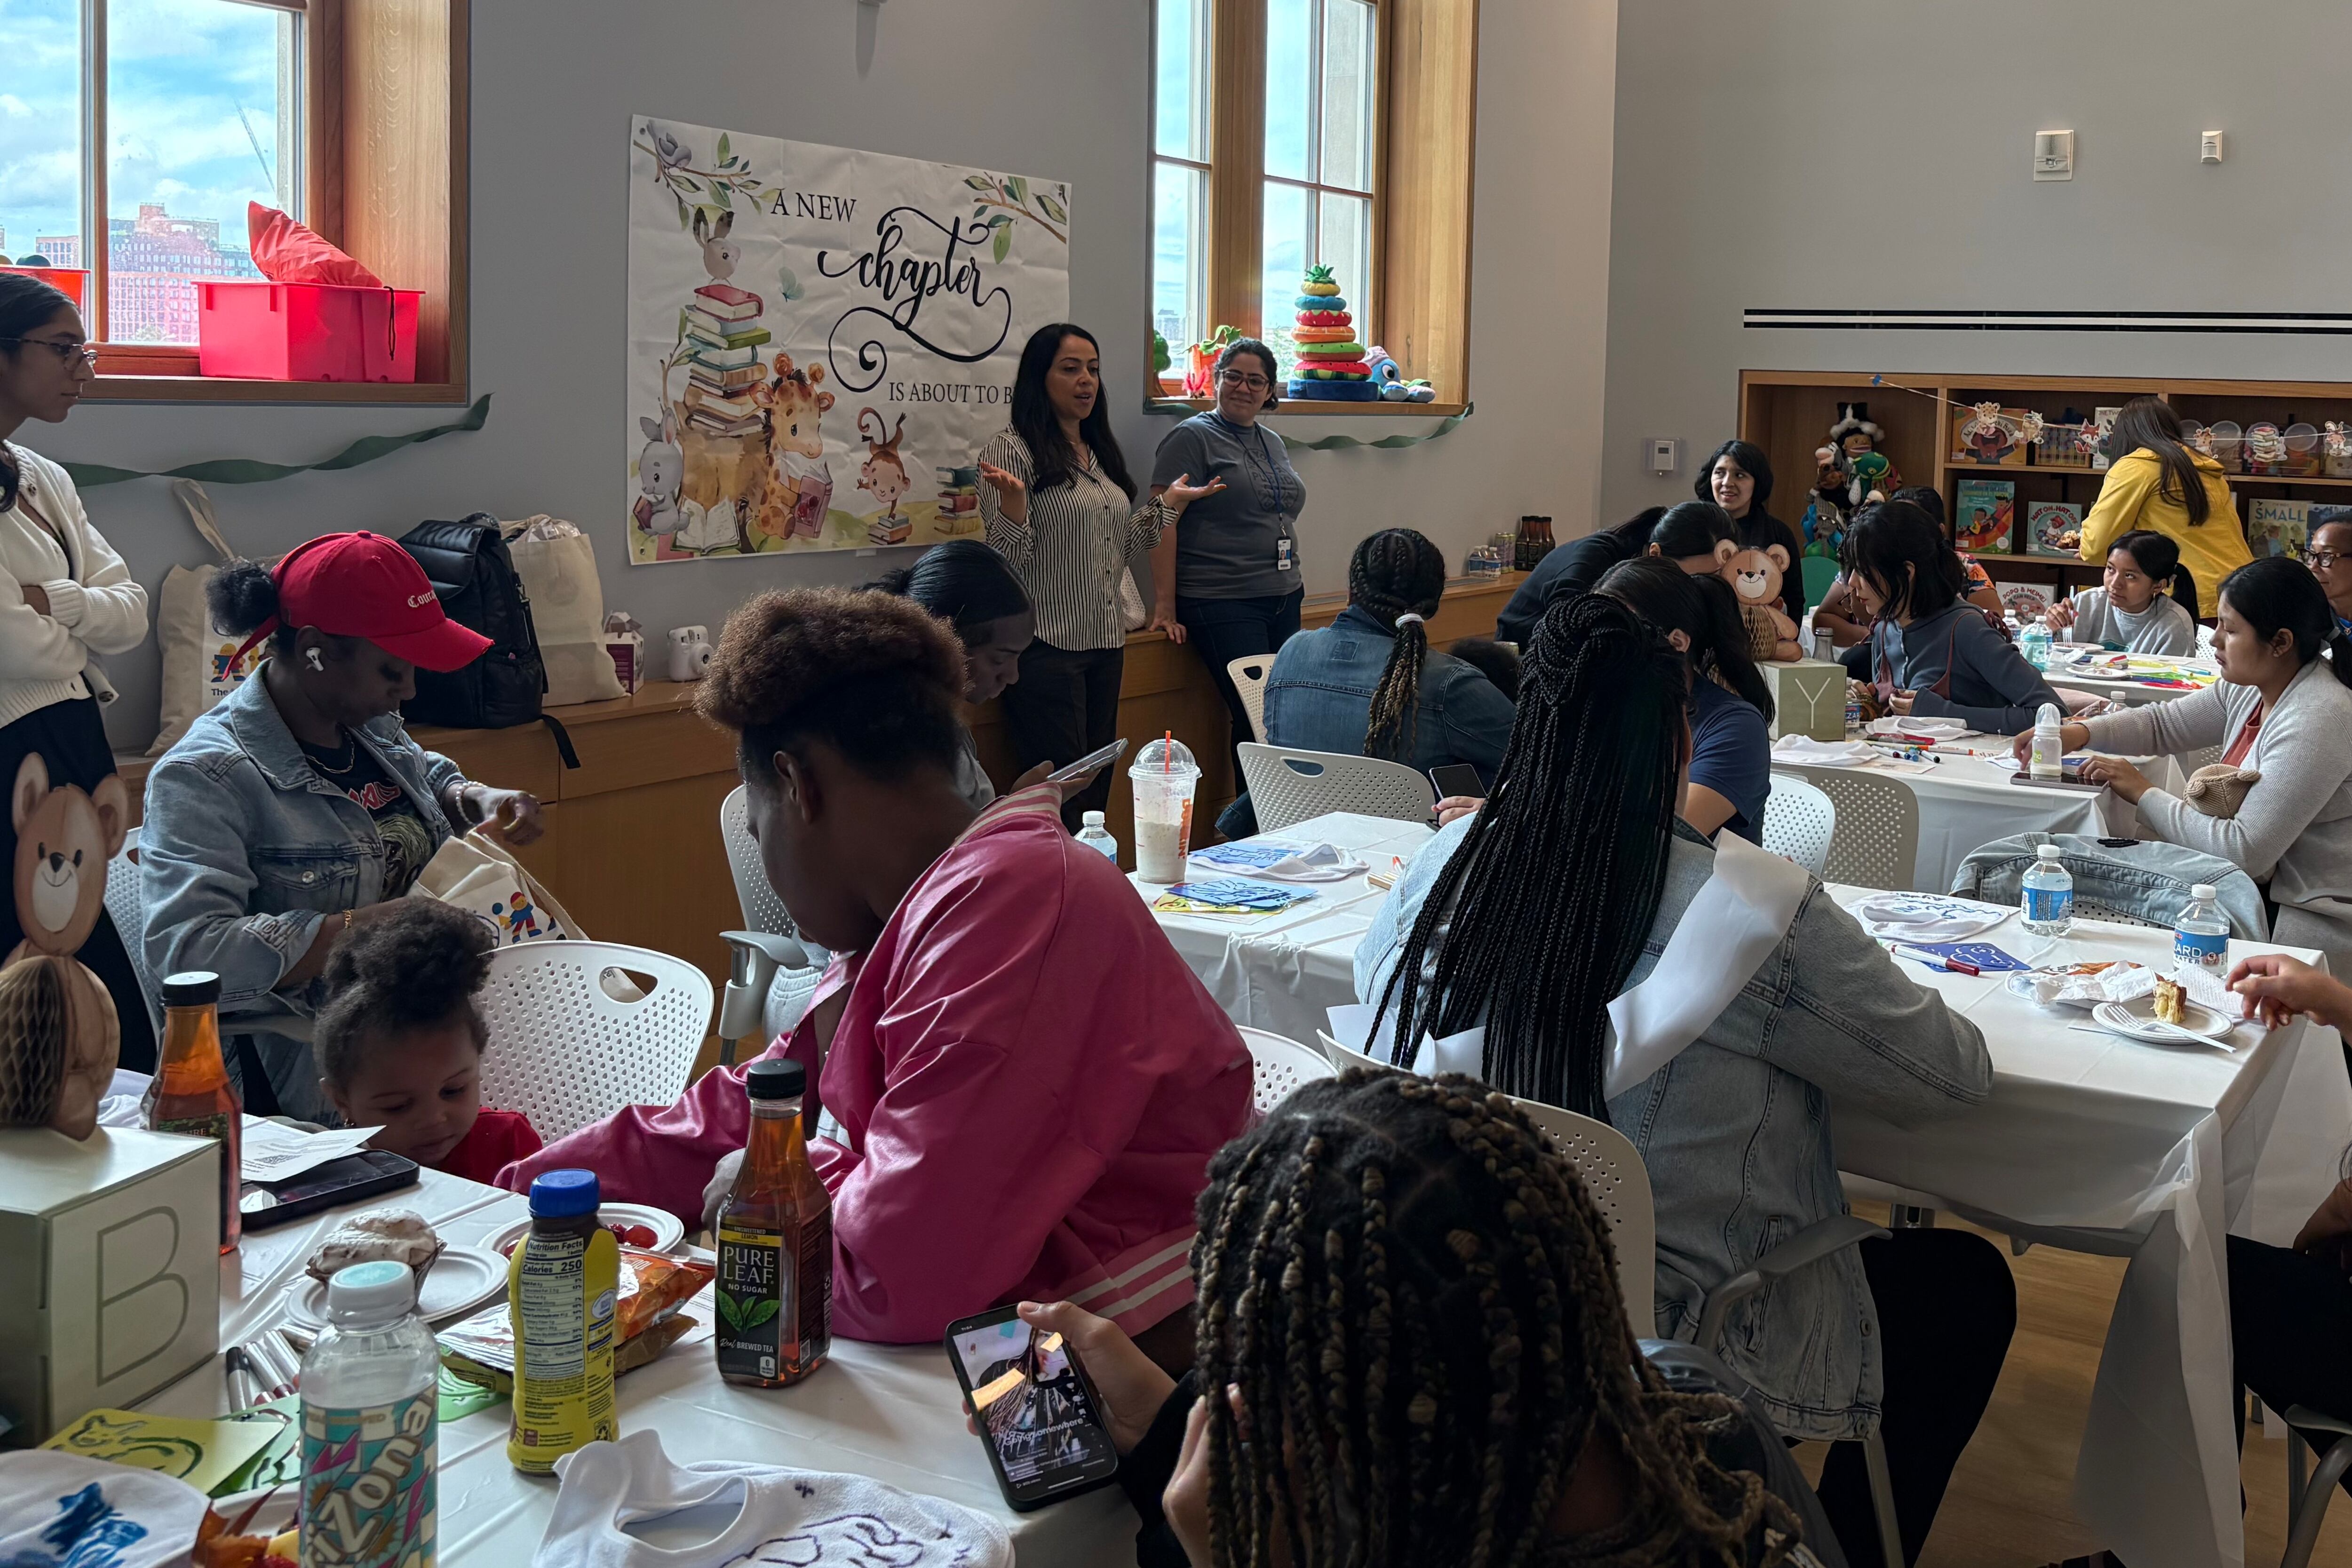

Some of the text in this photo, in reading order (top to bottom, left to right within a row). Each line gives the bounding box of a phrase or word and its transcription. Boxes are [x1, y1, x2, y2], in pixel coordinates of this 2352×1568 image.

[771, 189, 857, 223] A NEW
[889, 382, 904, 401] IS
[908, 382, 970, 403] ABOUT
[975, 385, 999, 404] TO
[2056, 505, 2071, 514] HAT
[2255, 508, 2305, 522] SMALL
[2002, 588, 2019, 600] POPO
[1795, 677, 1831, 729] Y
[528, 1241, 583, 1251] Nutrition Facts
[724, 1246, 774, 1267] PURE
[523, 1264, 553, 1273] Calories
[561, 1259, 582, 1271] 250
[97, 1206, 189, 1387] B
[742, 1285, 767, 1294] SUGAR
[720, 1338, 774, 1353] Real BREWED TEA
